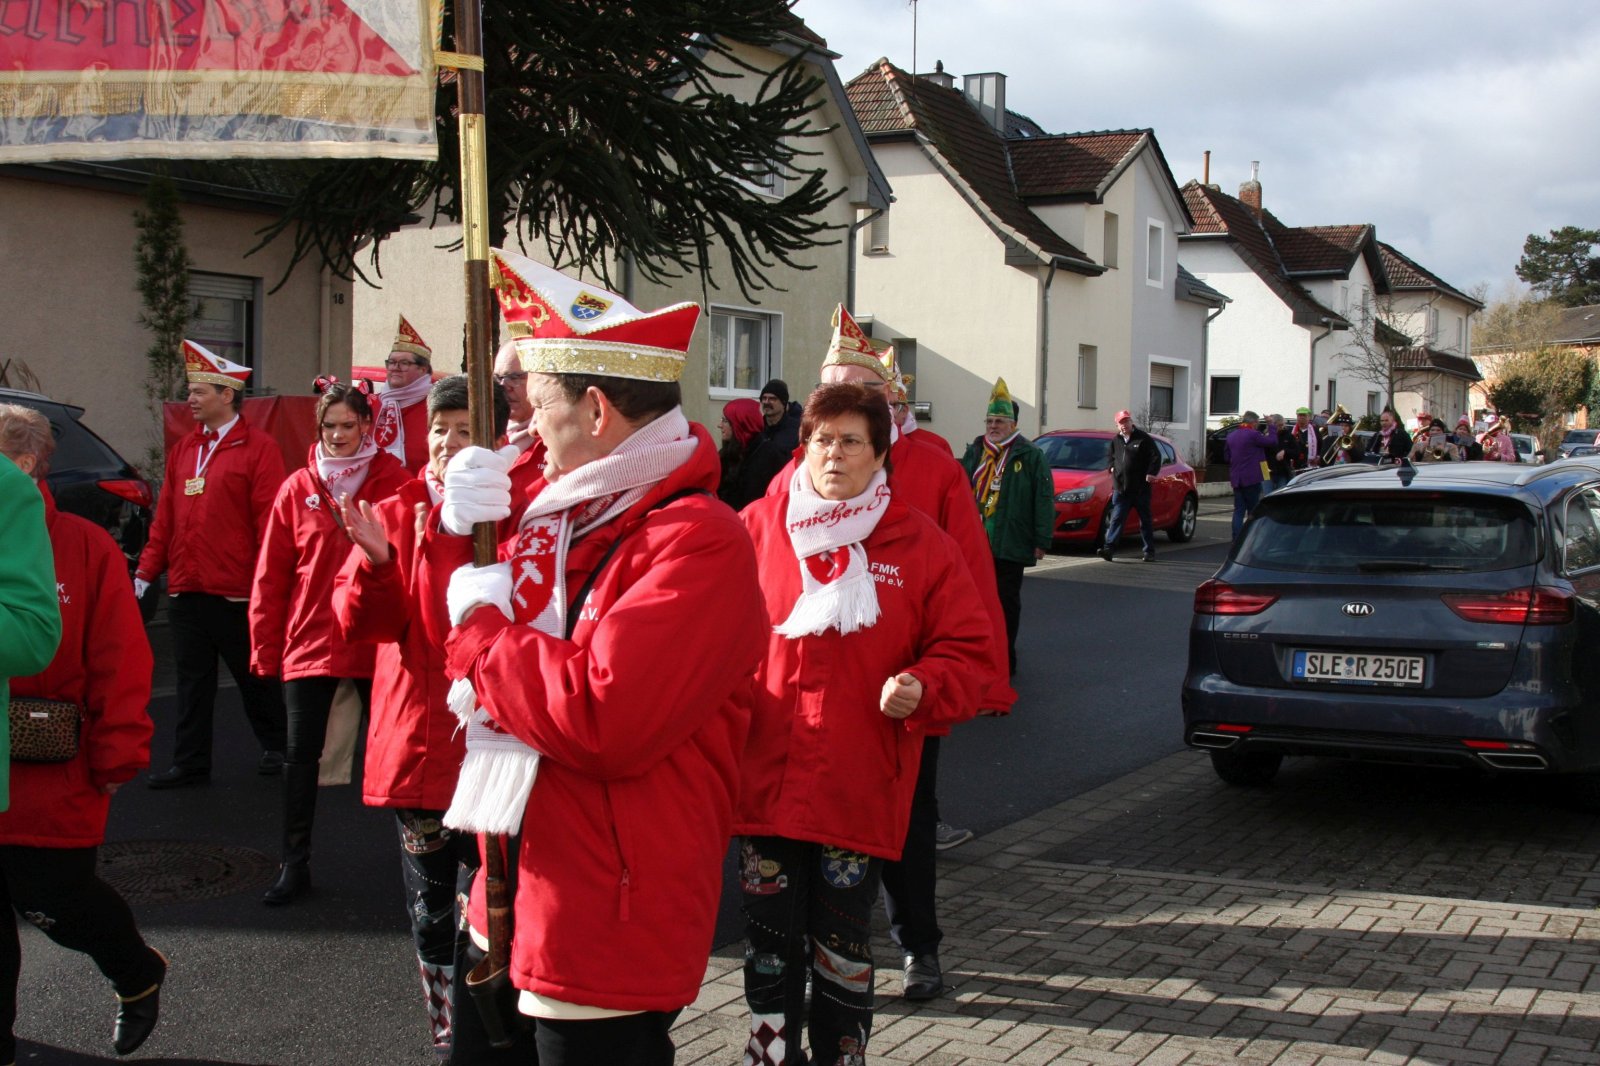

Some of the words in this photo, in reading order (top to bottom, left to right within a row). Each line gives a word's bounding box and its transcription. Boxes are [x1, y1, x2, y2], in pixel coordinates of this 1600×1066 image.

[870, 562, 900, 576] FMK
[872, 574, 886, 583] 60
[888, 578, 904, 588] e.V.
[1346, 604, 1369, 614] KIA
[1307, 654, 1343, 676] SLE
[1355, 657, 1368, 678] R
[1372, 658, 1420, 680] 250E
